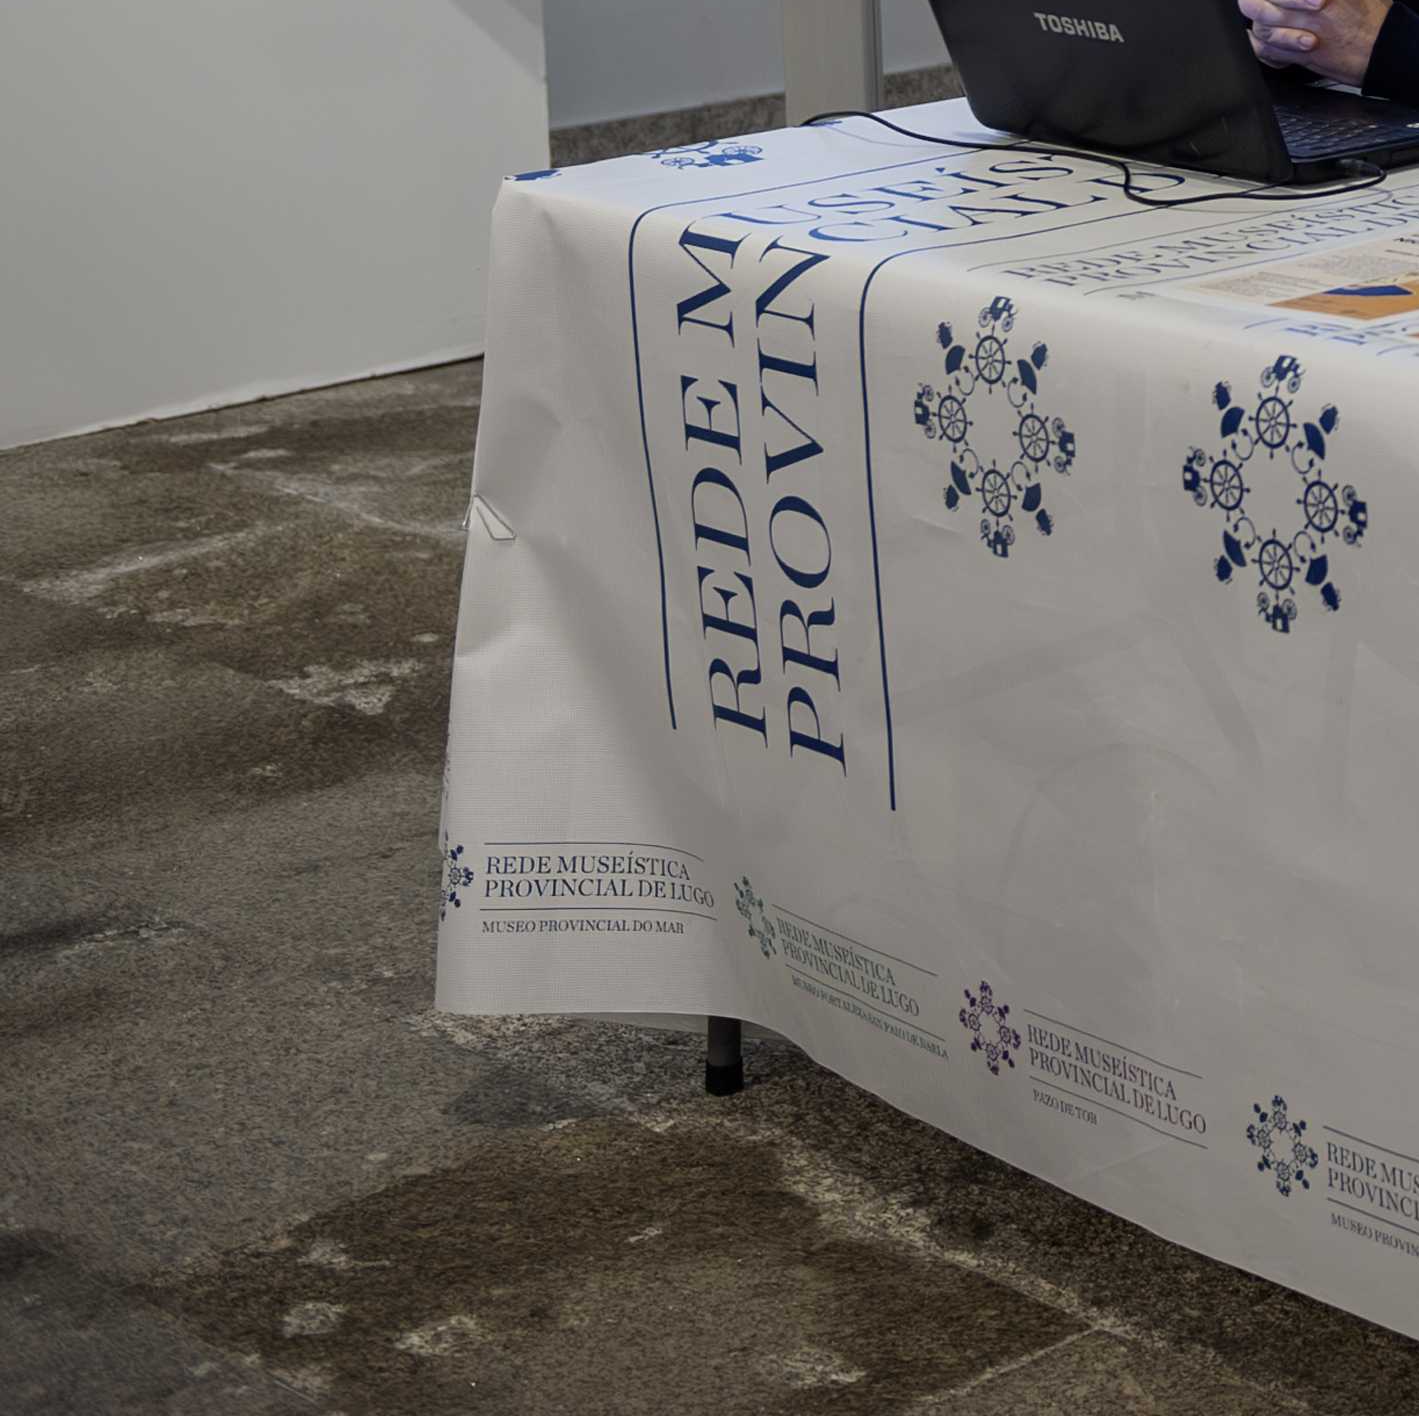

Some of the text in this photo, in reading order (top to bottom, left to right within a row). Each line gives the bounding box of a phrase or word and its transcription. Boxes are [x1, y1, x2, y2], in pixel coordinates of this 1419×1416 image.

[1033, 11, 1125, 44] TOSHIBA
[1002, 250, 1164, 280] REDE
[1042, 224, 1374, 287] PROVINCIAL
[753, 191, 1107, 779] PROVINCIAL
[680, 374, 769, 749] REDE
[486, 850, 690, 880] REDE MUSEÍSTICA
[484, 879, 715, 908] PROVINCIAL DE LUGO
[482, 919, 684, 934] MUSEO PROVINCIAL DO MAR
[780, 938, 920, 1017] PROVINCIAL DE LUGO
[812, 934, 896, 986] MUSEÍSTICA
[1027, 1023, 1177, 1101] REDE MUSEÍSTICA
[1029, 1047, 1207, 1135] PROVINCIAL DE LUGO
[1033, 1089, 1098, 1125] PAZO DE TOR
[1327, 1142, 1377, 1180] REDE
[1331, 1212, 1373, 1240] MUSEO
